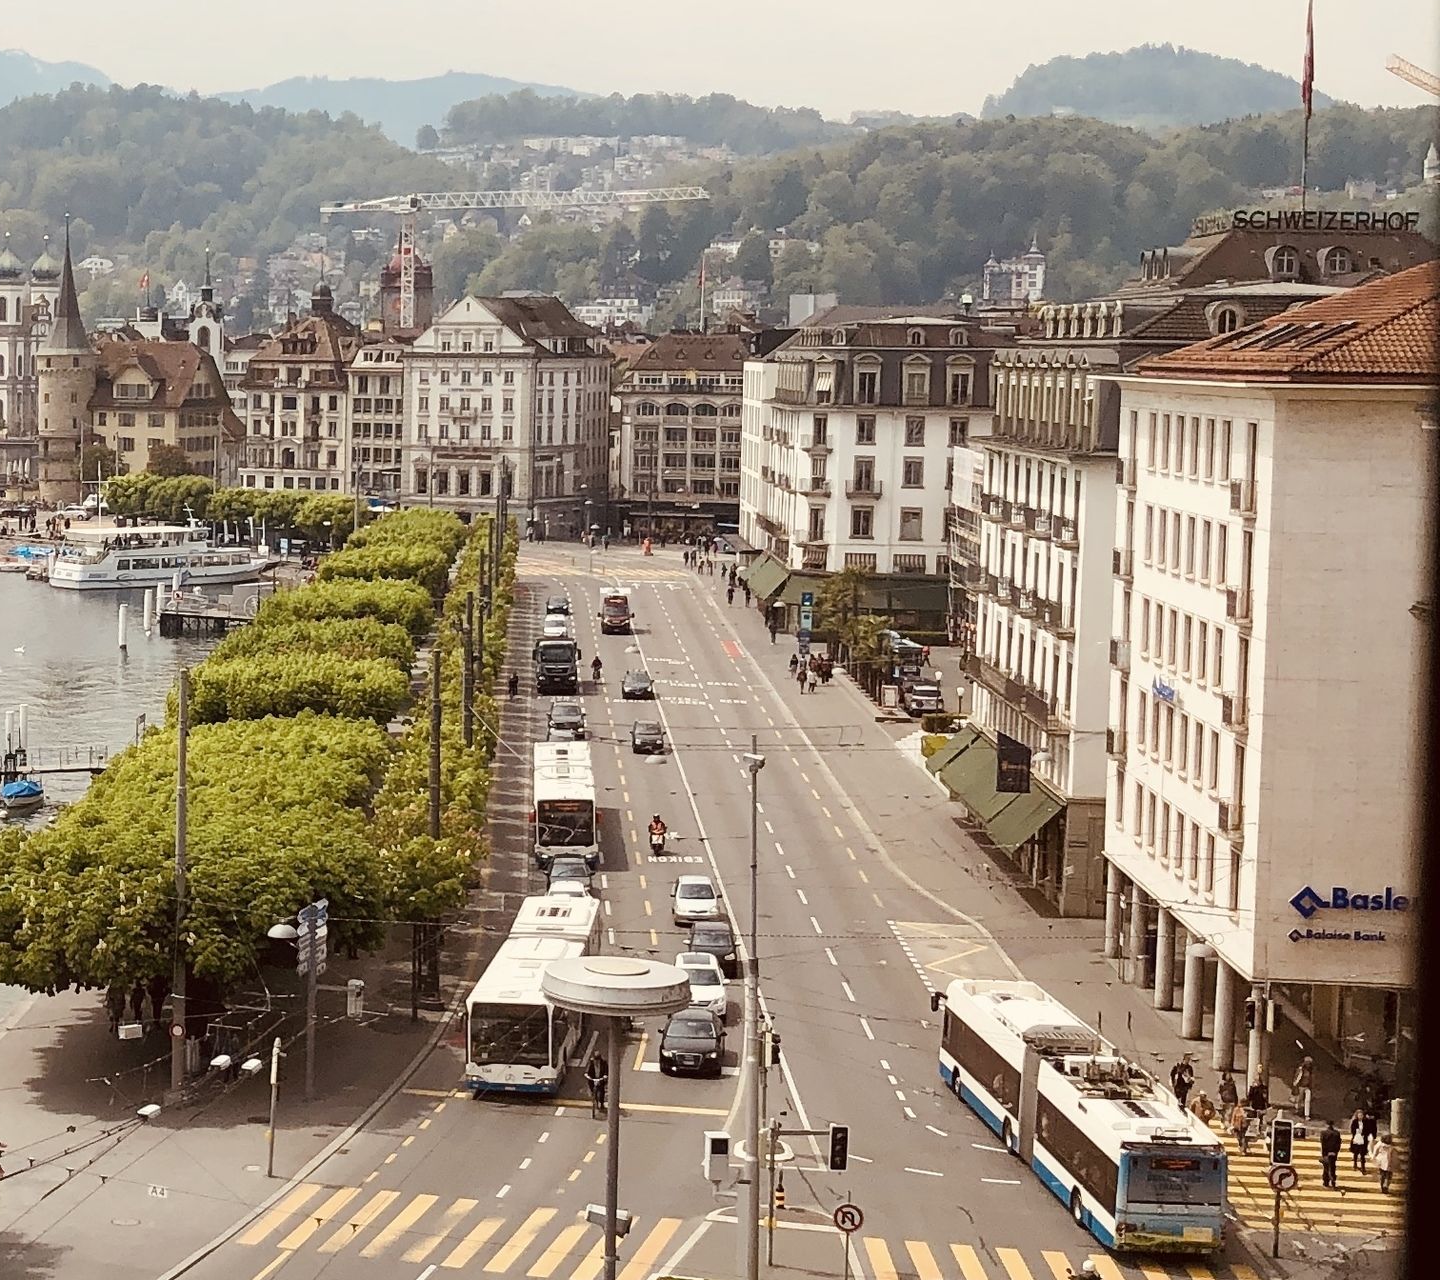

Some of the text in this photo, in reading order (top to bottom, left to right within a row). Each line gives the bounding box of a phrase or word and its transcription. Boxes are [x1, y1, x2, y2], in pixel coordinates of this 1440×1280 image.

[1232, 210, 1419, 231] SCHWEIZERHOF
[1332, 887, 1410, 911] Basle
[1354, 930, 1386, 942] Bank
